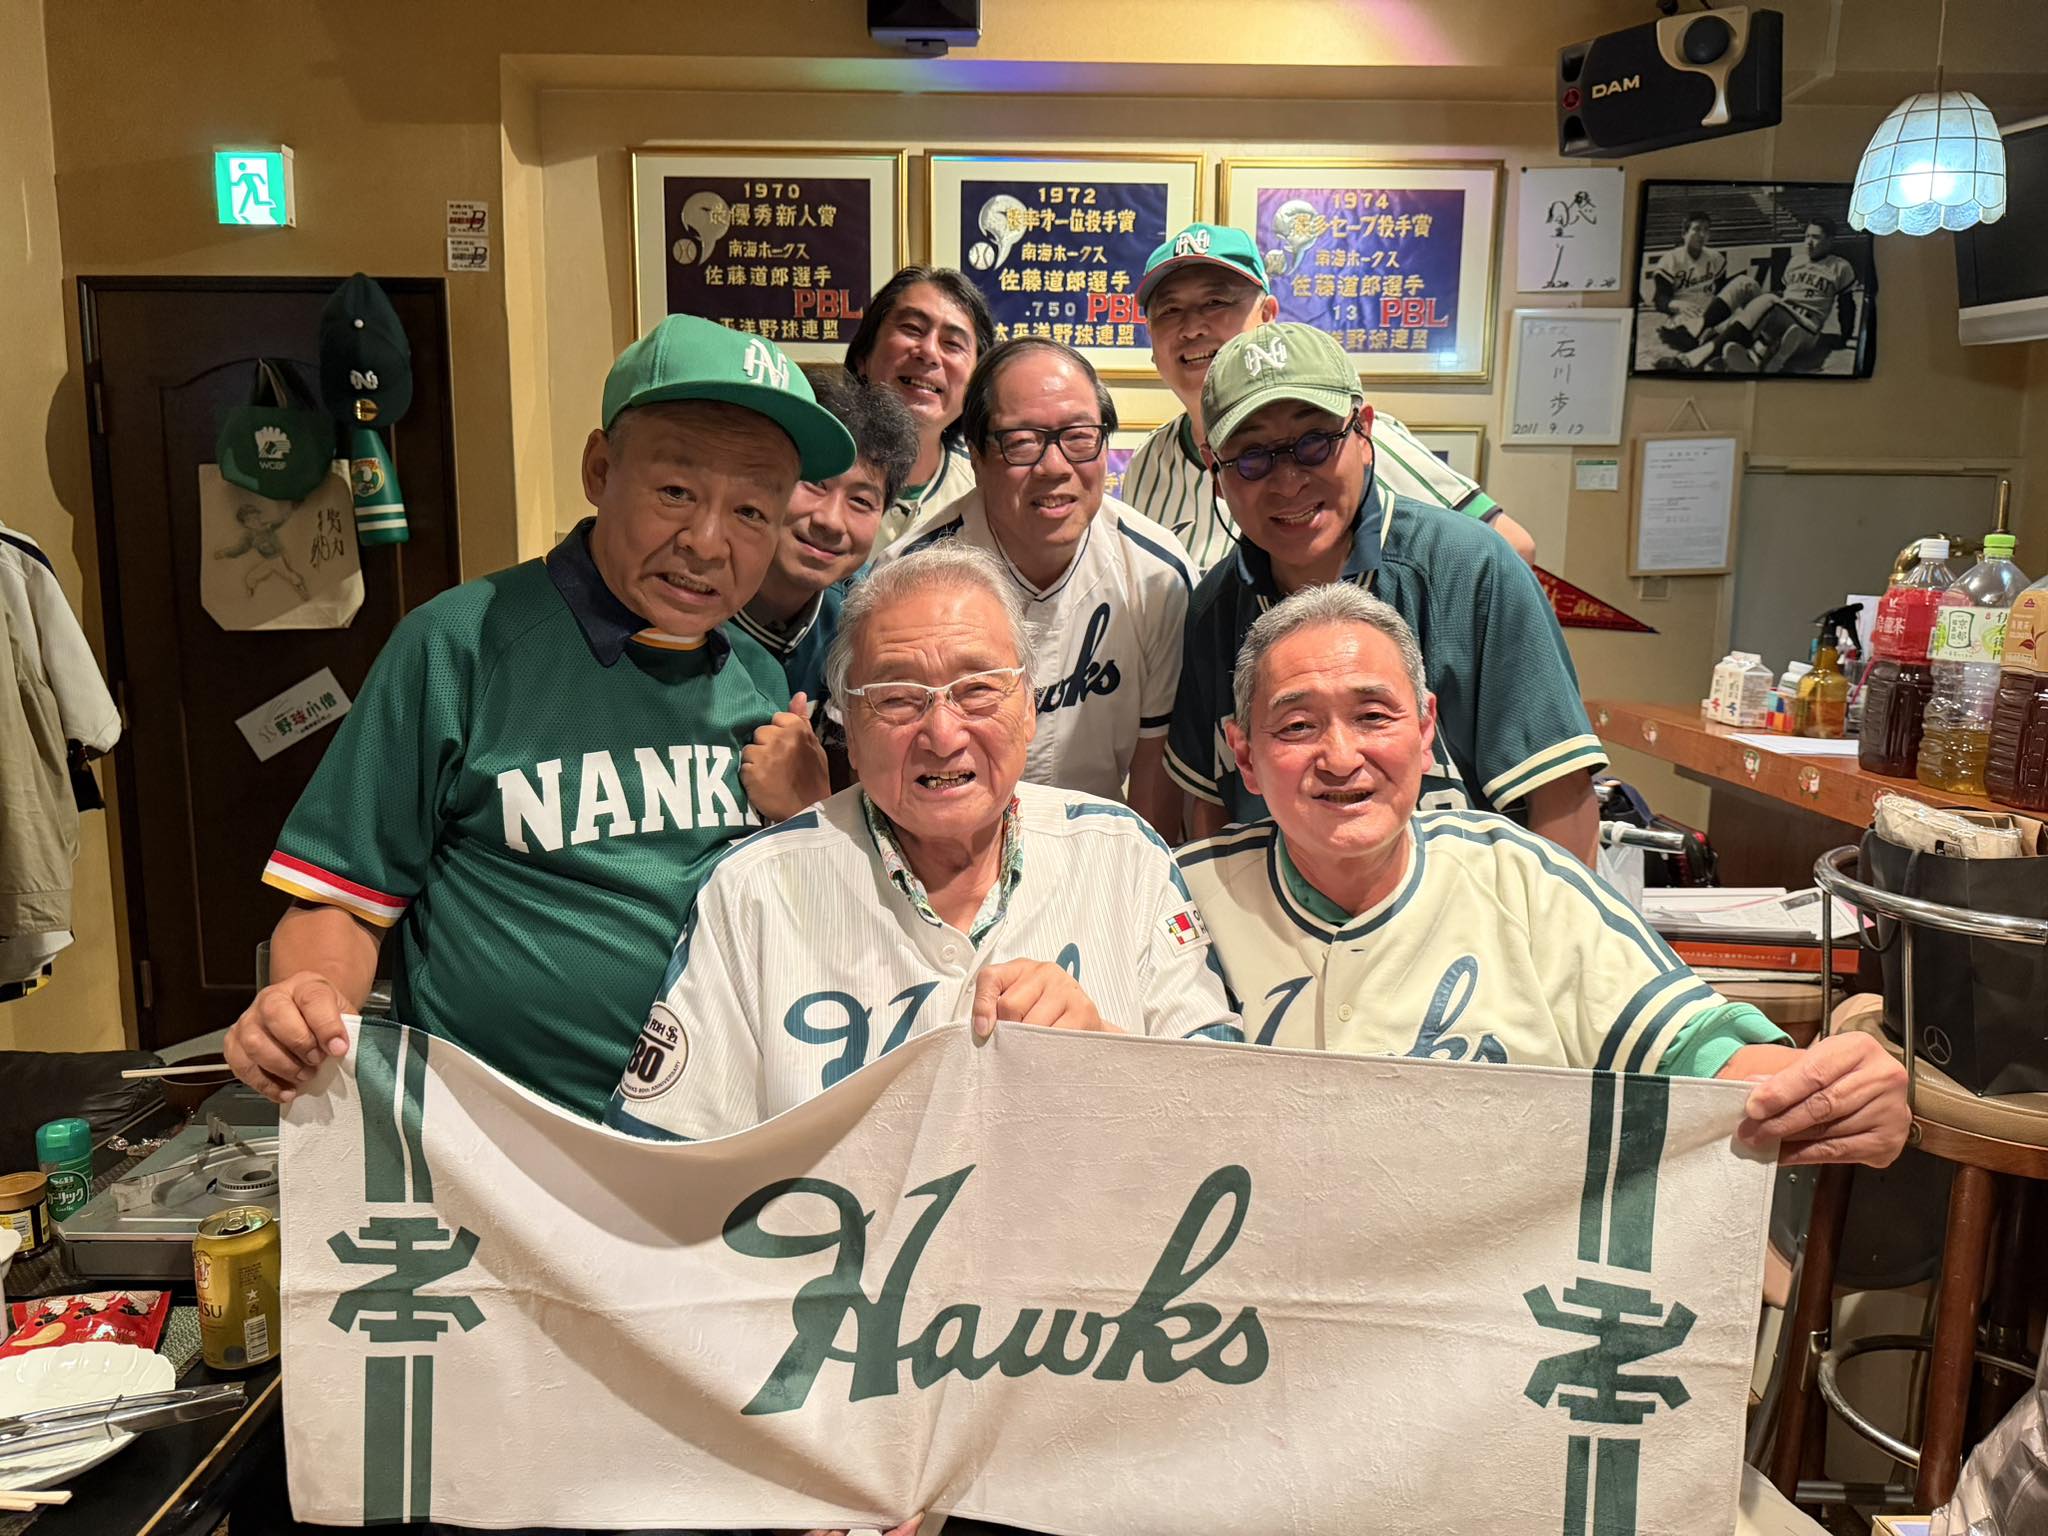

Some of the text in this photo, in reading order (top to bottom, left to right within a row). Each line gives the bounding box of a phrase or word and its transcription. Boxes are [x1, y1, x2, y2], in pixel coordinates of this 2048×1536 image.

[1592, 75, 1641, 99] DAM
[744, 182, 801, 199] 1970
[1038, 187, 1097, 204] 1972
[1333, 192, 1389, 209] 1974
[709, 204, 837, 228] 最優秀新人賞
[728, 240, 810, 260] 南海ホークス
[1021, 242, 1108, 264] 南海ホークス
[1315, 250, 1400, 268] 南海ホークス
[705, 265, 832, 287] 佐藤道郎選手
[999, 268, 1131, 292] 佐藤道郎選手
[1291, 274, 1425, 297] 佐藤道郎選手
[793, 289, 864, 320] PBL
[1025, 301, 1077, 316] .750
[1333, 305, 1358, 321] 13
[1379, 298, 1449, 328] PBL
[1550, 339, 1576, 417] 石川歩
[497, 744, 762, 854] NANK
[627, 1036, 665, 1083] 80
